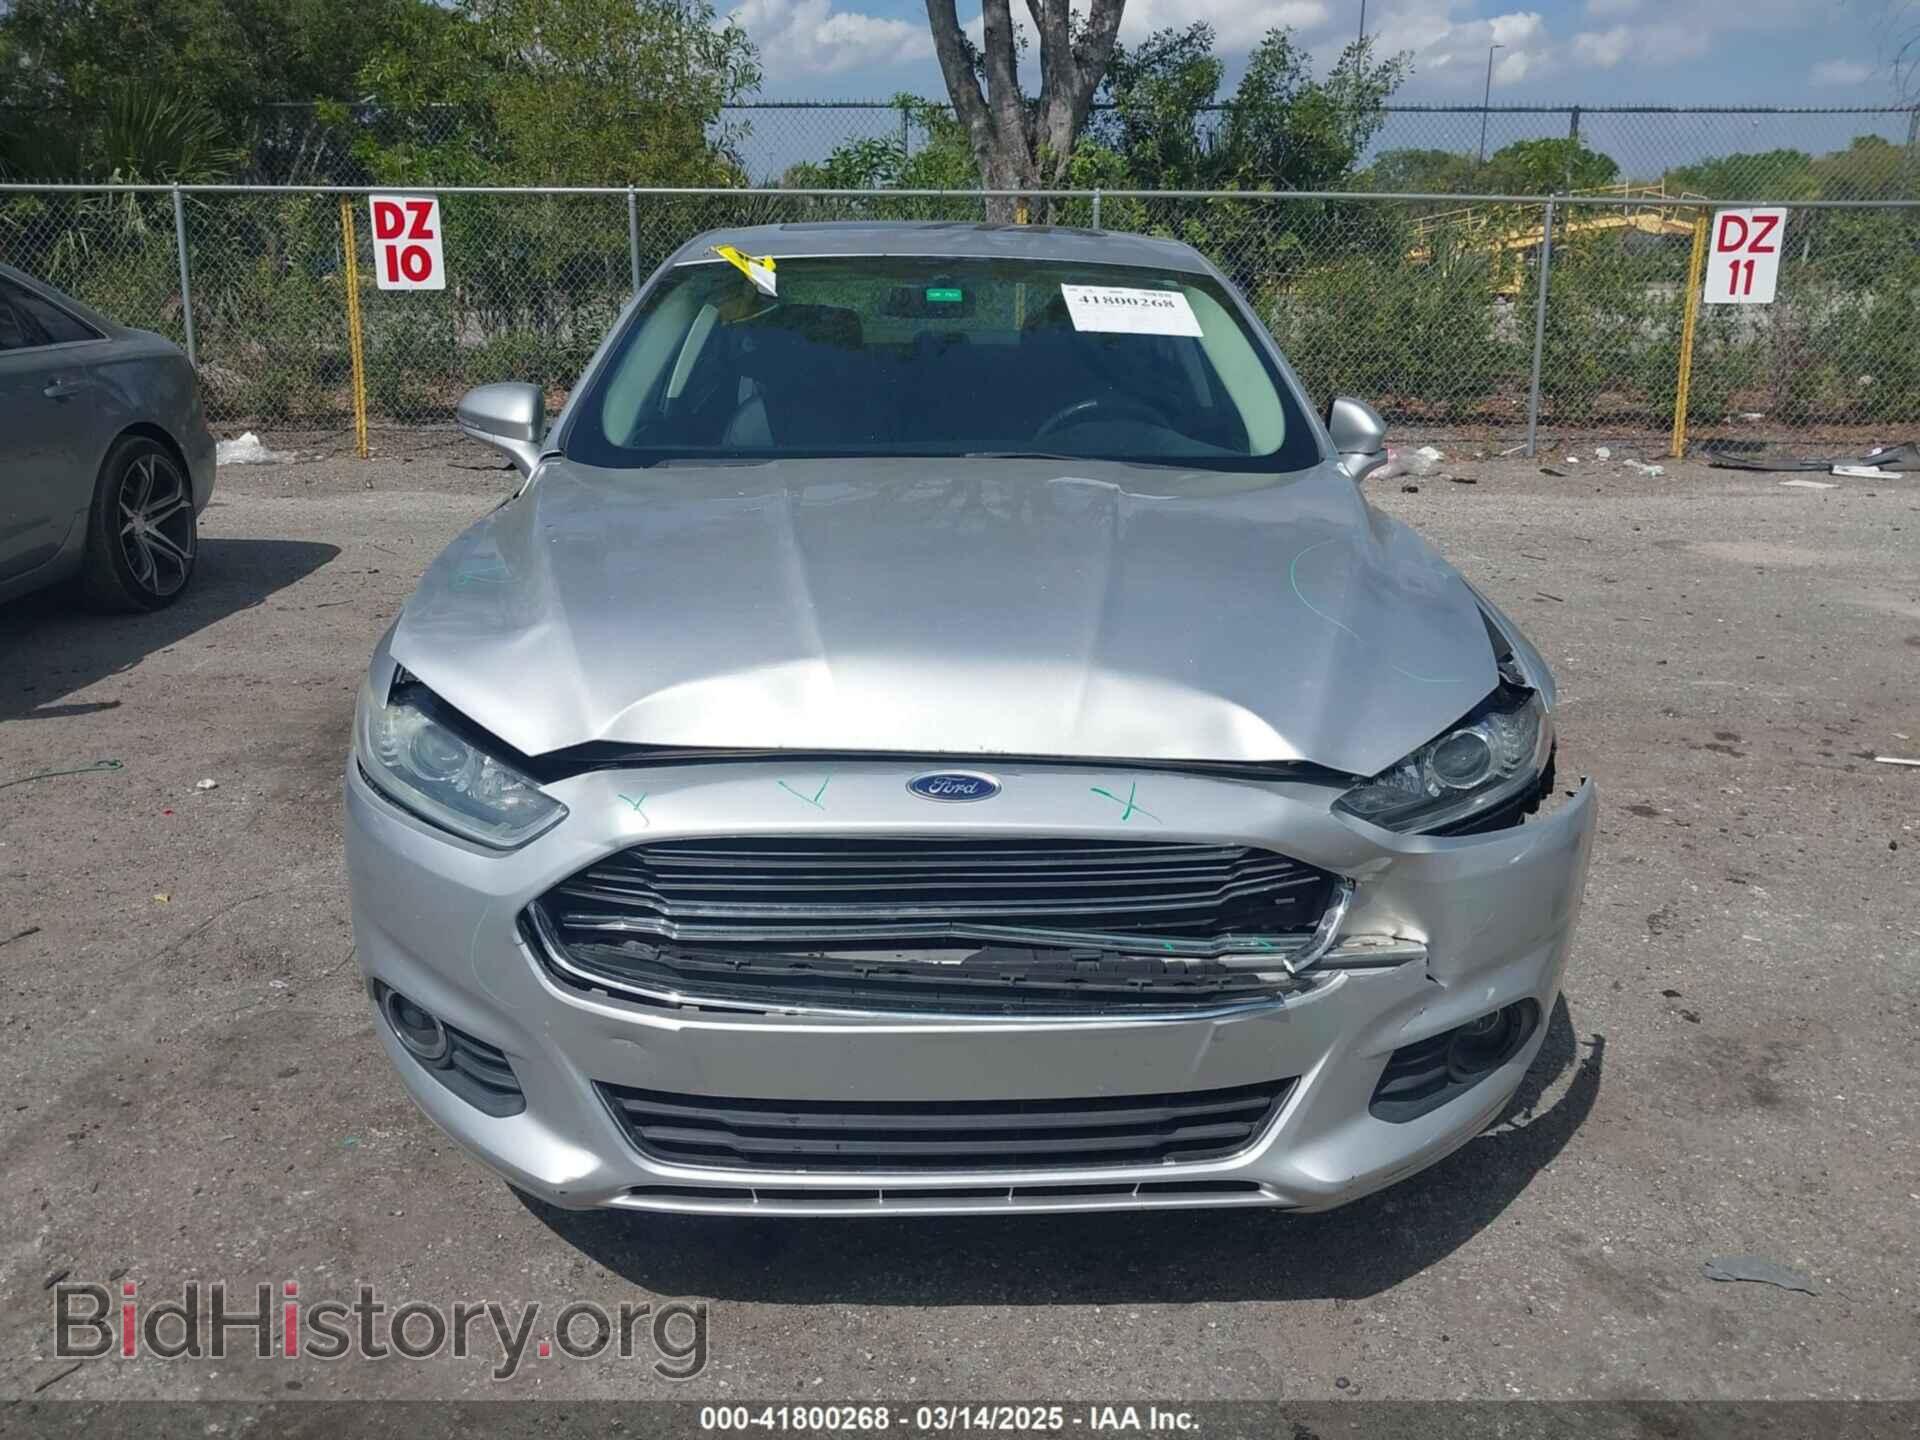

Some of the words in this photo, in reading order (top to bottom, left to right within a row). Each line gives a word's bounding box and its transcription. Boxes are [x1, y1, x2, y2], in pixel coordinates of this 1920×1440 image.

[373, 201, 434, 239] DZ
[1717, 215, 1779, 253] DZ
[384, 244, 433, 282] 10
[1728, 259, 1755, 295] 11
[1079, 295, 1175, 308] 41800268
[928, 777, 979, 794] Ford
